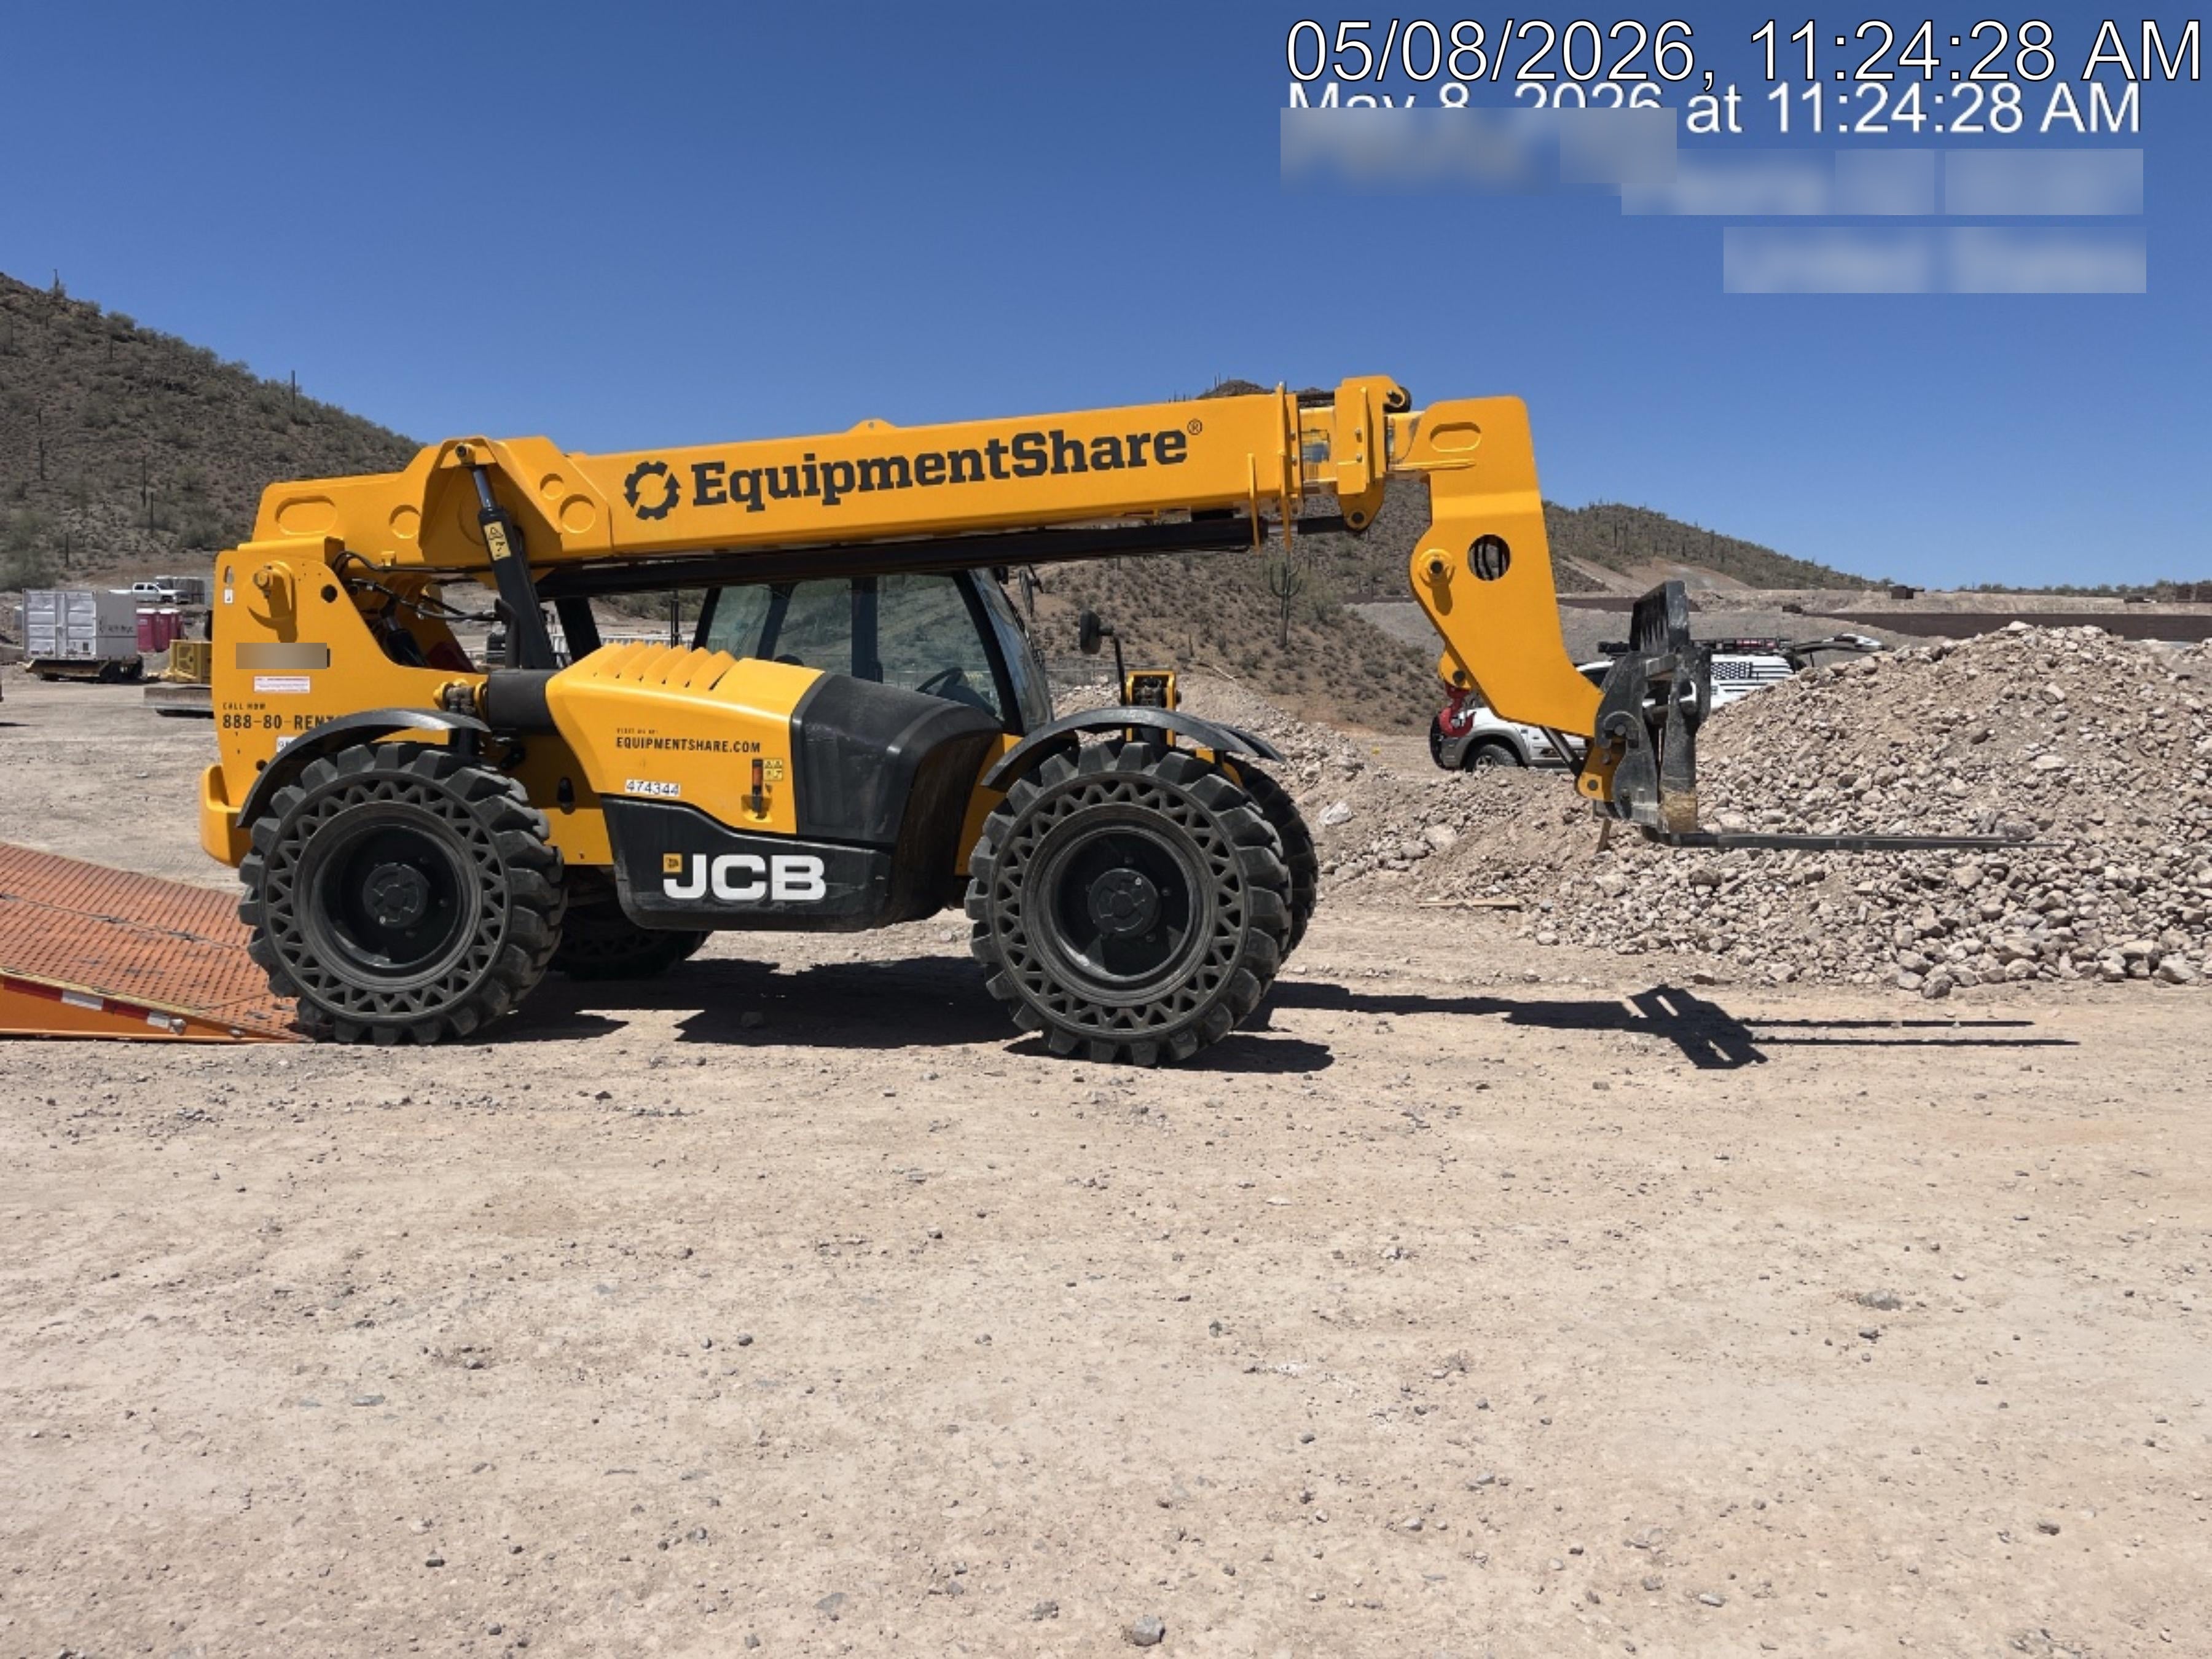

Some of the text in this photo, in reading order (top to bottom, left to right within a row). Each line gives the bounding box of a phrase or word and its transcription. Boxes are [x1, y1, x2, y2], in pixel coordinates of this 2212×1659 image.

[616, 737, 761, 753] EQUIPMENTSHARE.COM
[626, 780, 679, 796] 474344
[663, 853, 826, 900] JCB
